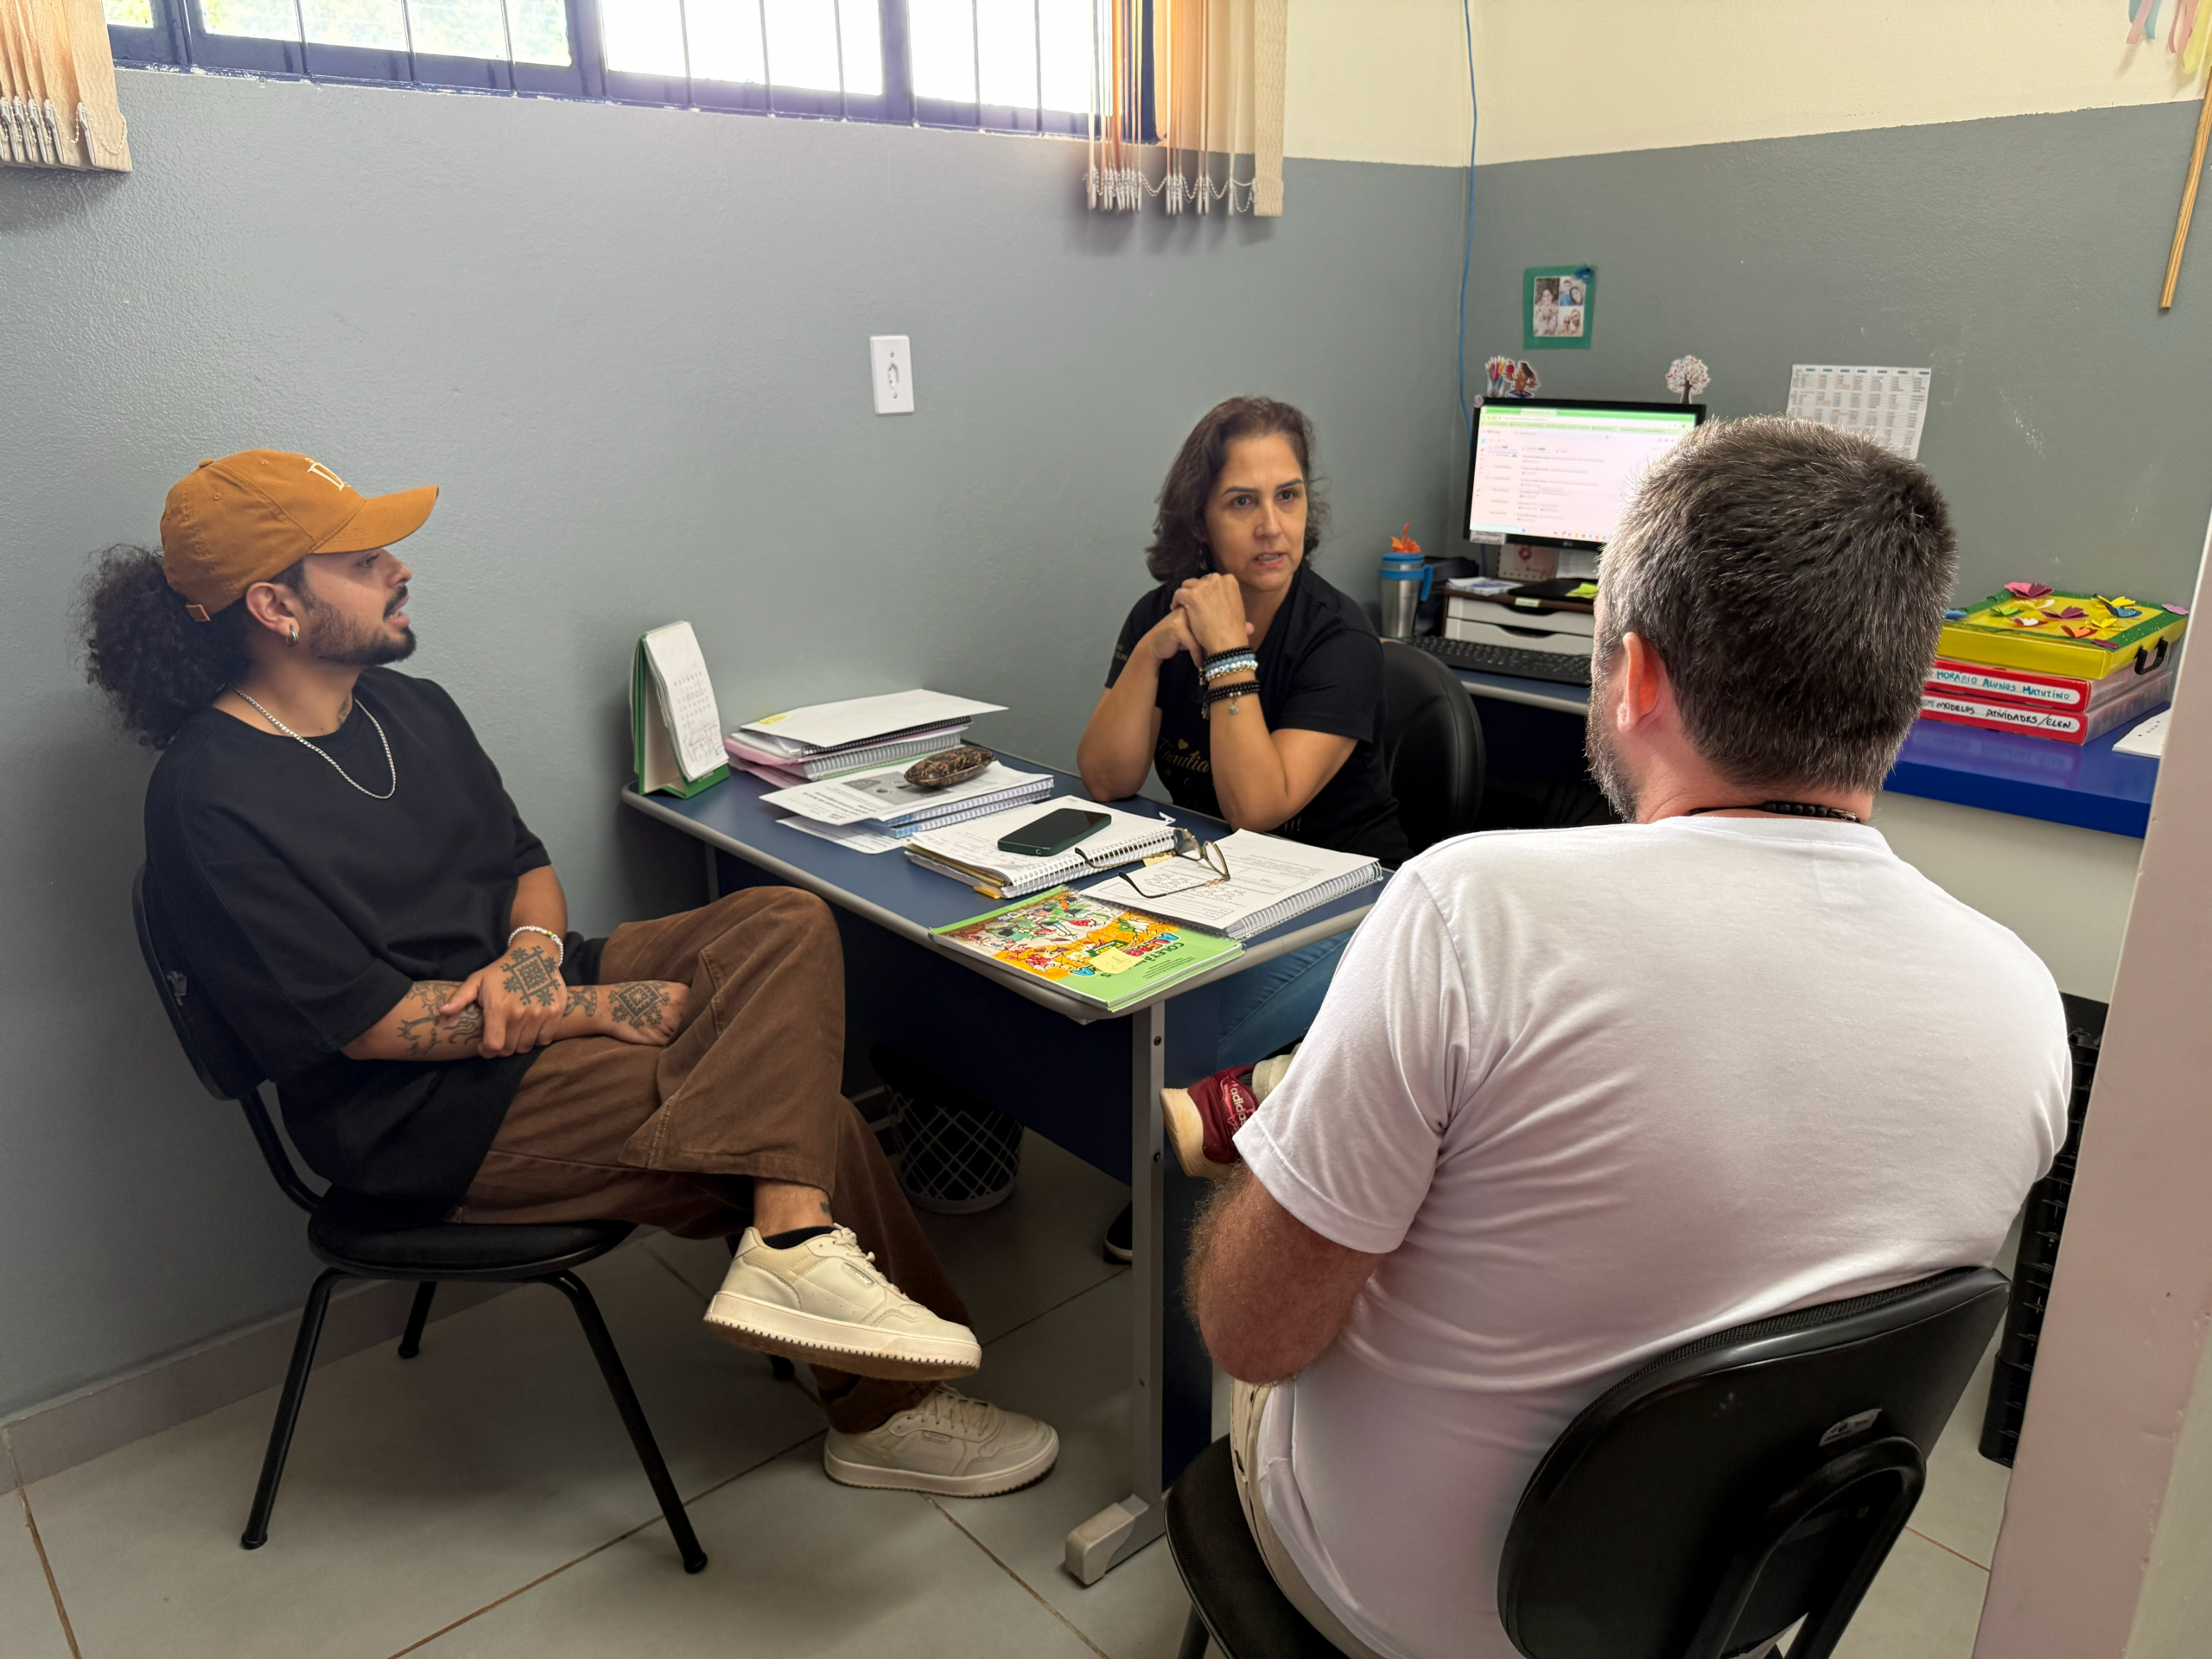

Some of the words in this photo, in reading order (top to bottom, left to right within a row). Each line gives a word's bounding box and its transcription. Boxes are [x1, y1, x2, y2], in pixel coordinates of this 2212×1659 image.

[1982, 678, 2017, 692] ALUNOS
[2022, 685, 2070, 700] MATUTINO
[1936, 702, 1975, 715] MODELOS
